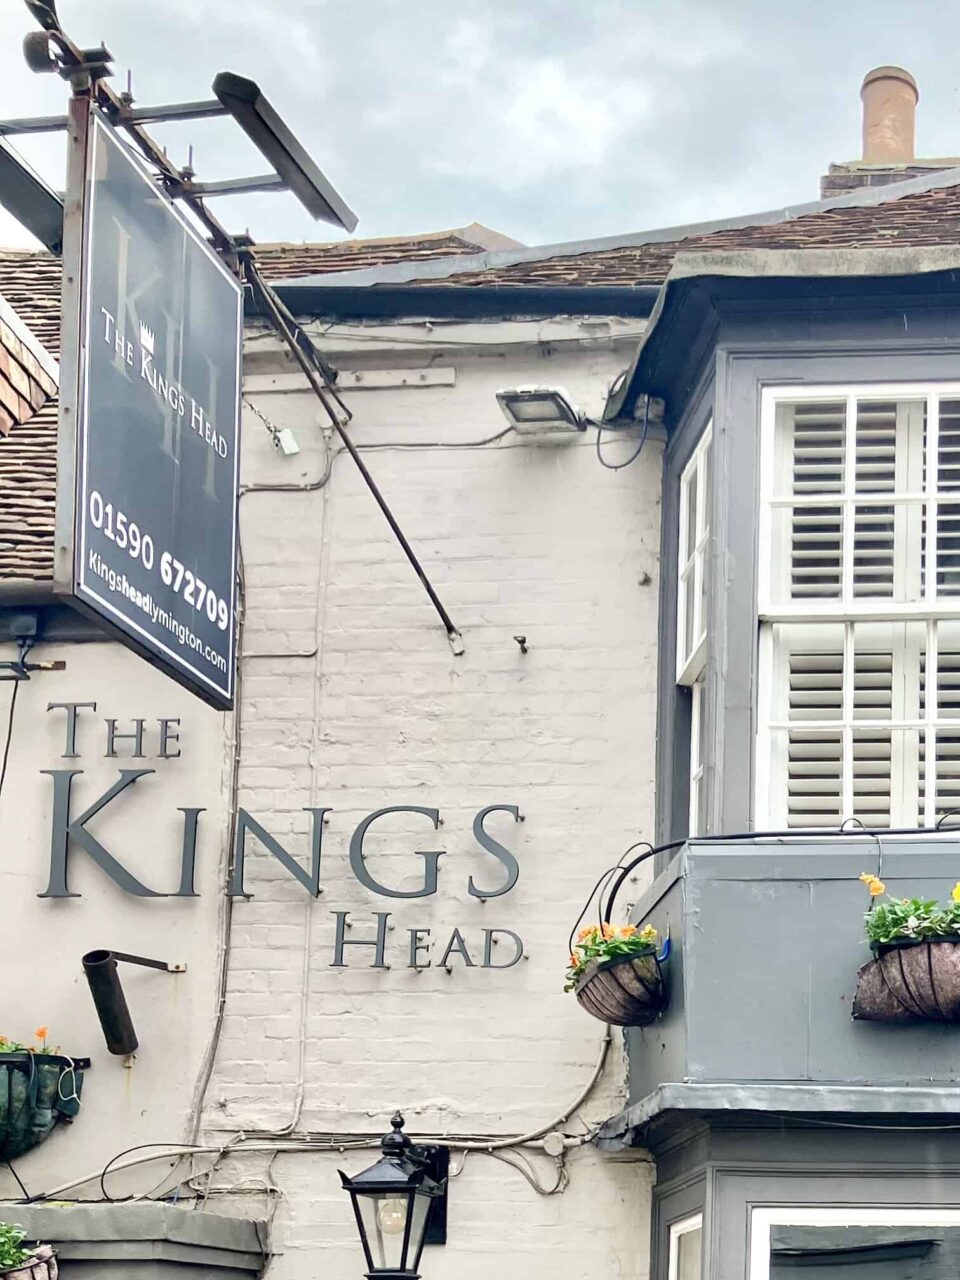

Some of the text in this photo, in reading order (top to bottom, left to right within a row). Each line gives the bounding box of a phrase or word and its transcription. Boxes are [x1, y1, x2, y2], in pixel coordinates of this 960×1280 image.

[101, 306, 133, 366] THE
[190, 398, 228, 458] HEAD
[89, 490, 228, 631] 01590 672709
[89, 548, 227, 673] Kingsheadlymington.com
[46, 701, 182, 759] THE
[36, 768, 520, 899] KINGS
[329, 911, 524, 969] HEAD
